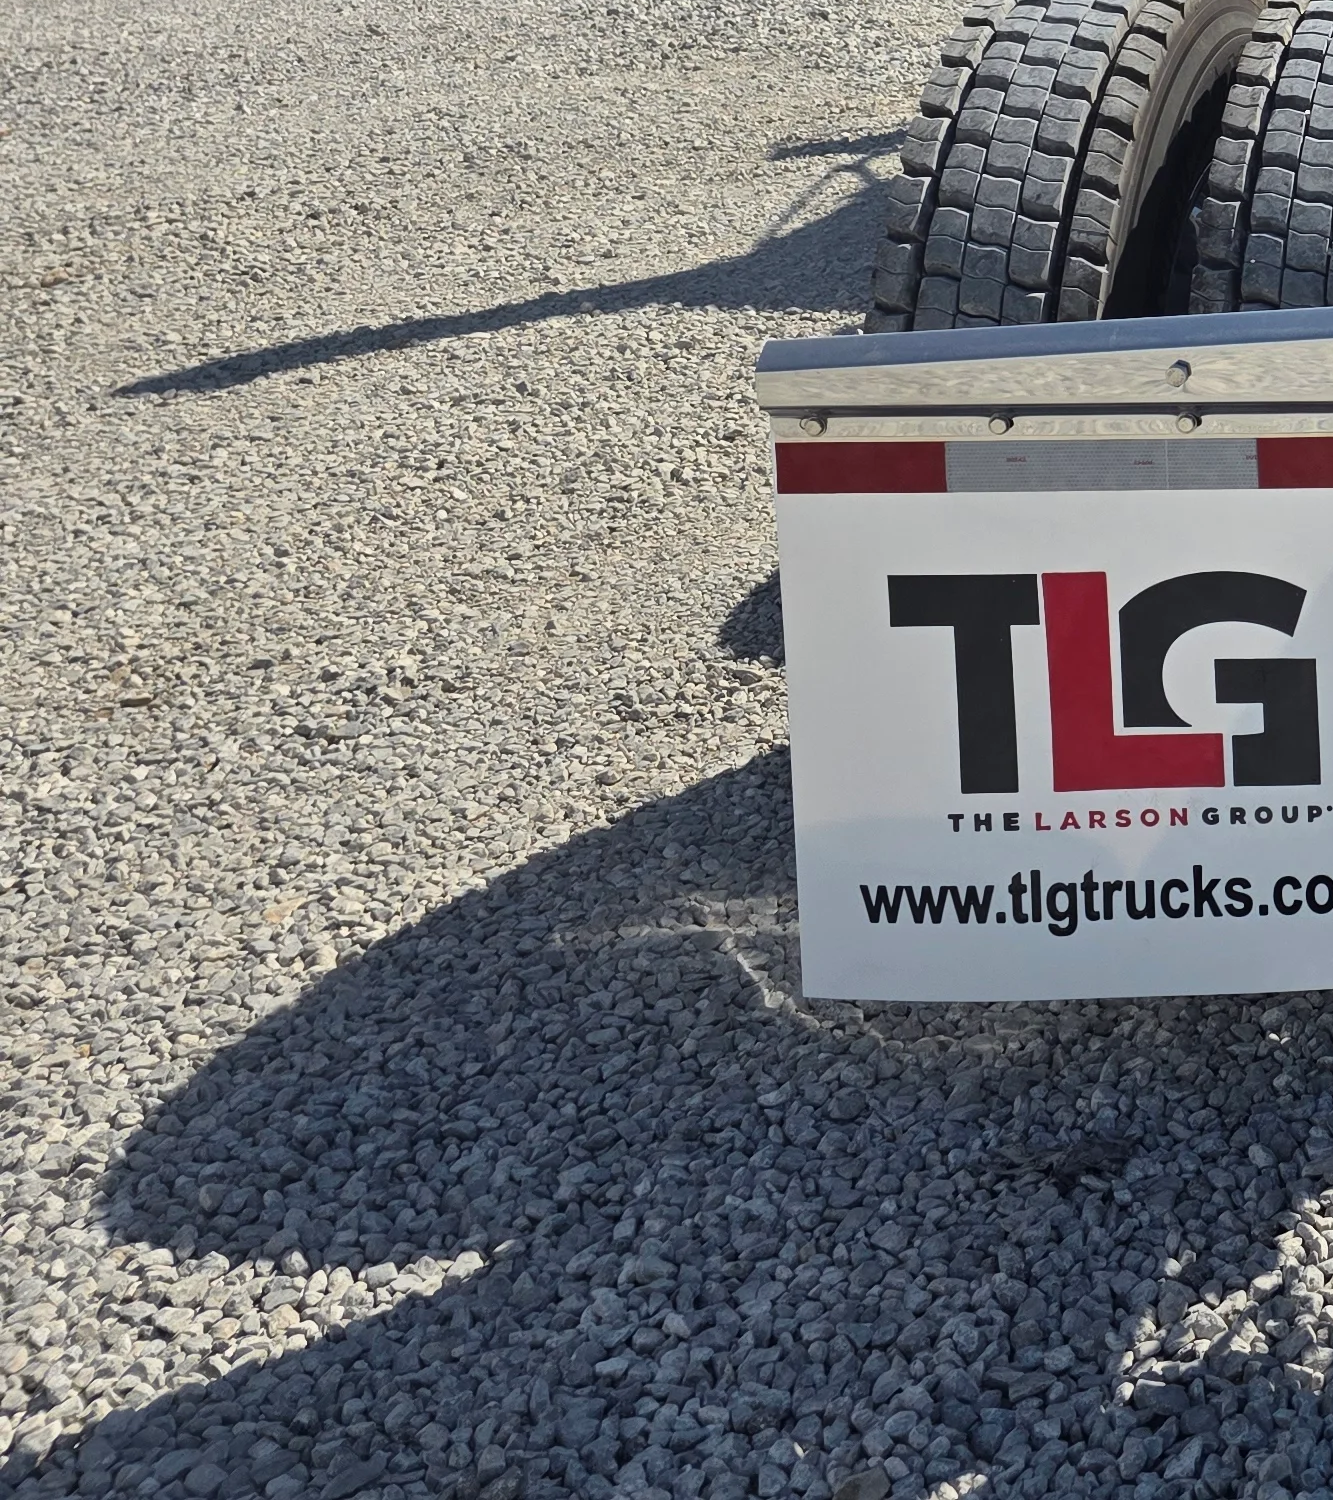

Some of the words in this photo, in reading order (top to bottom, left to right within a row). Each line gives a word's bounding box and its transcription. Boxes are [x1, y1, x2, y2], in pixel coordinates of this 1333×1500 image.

[886, 570, 1322, 795] TLG
[947, 812, 1021, 833] THE
[1034, 806, 1189, 832] LARSON
[1201, 805, 1324, 826] GROUP
